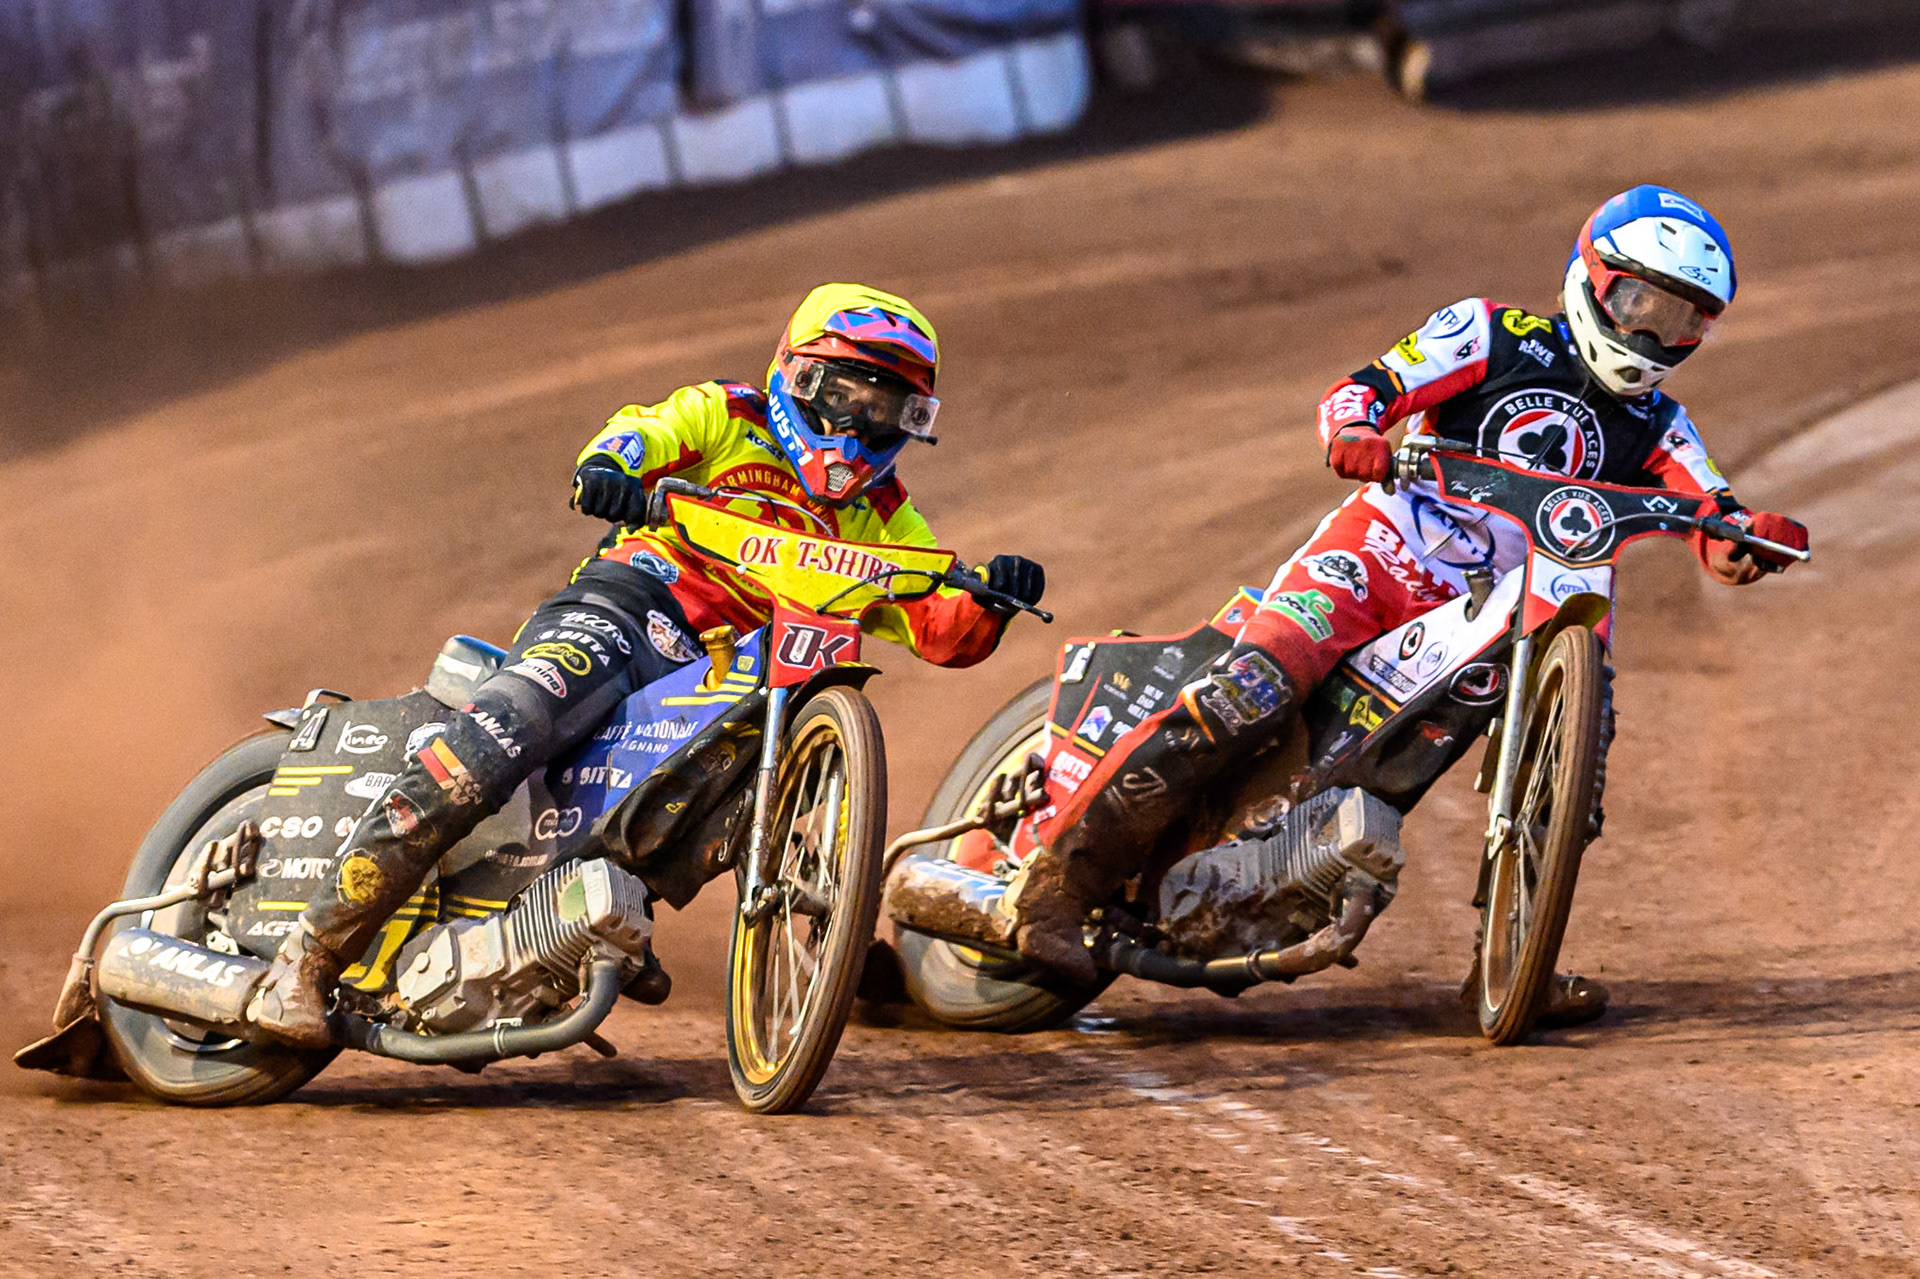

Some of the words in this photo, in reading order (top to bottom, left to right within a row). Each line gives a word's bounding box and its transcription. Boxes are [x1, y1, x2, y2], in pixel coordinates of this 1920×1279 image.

[1503, 395, 1554, 416] BELLE
[1561, 400, 1590, 426] VUE
[1584, 429, 1599, 468] ACES
[712, 468, 801, 498] IRMINGHAM
[1543, 491, 1568, 513] BELLE
[1571, 490, 1591, 502] VUE
[738, 535, 784, 565] OK
[796, 541, 901, 591] T-SHIRT
[468, 711, 522, 758] ANLAS
[259, 815, 324, 839] CSO
[149, 946, 246, 987] ANLAS
